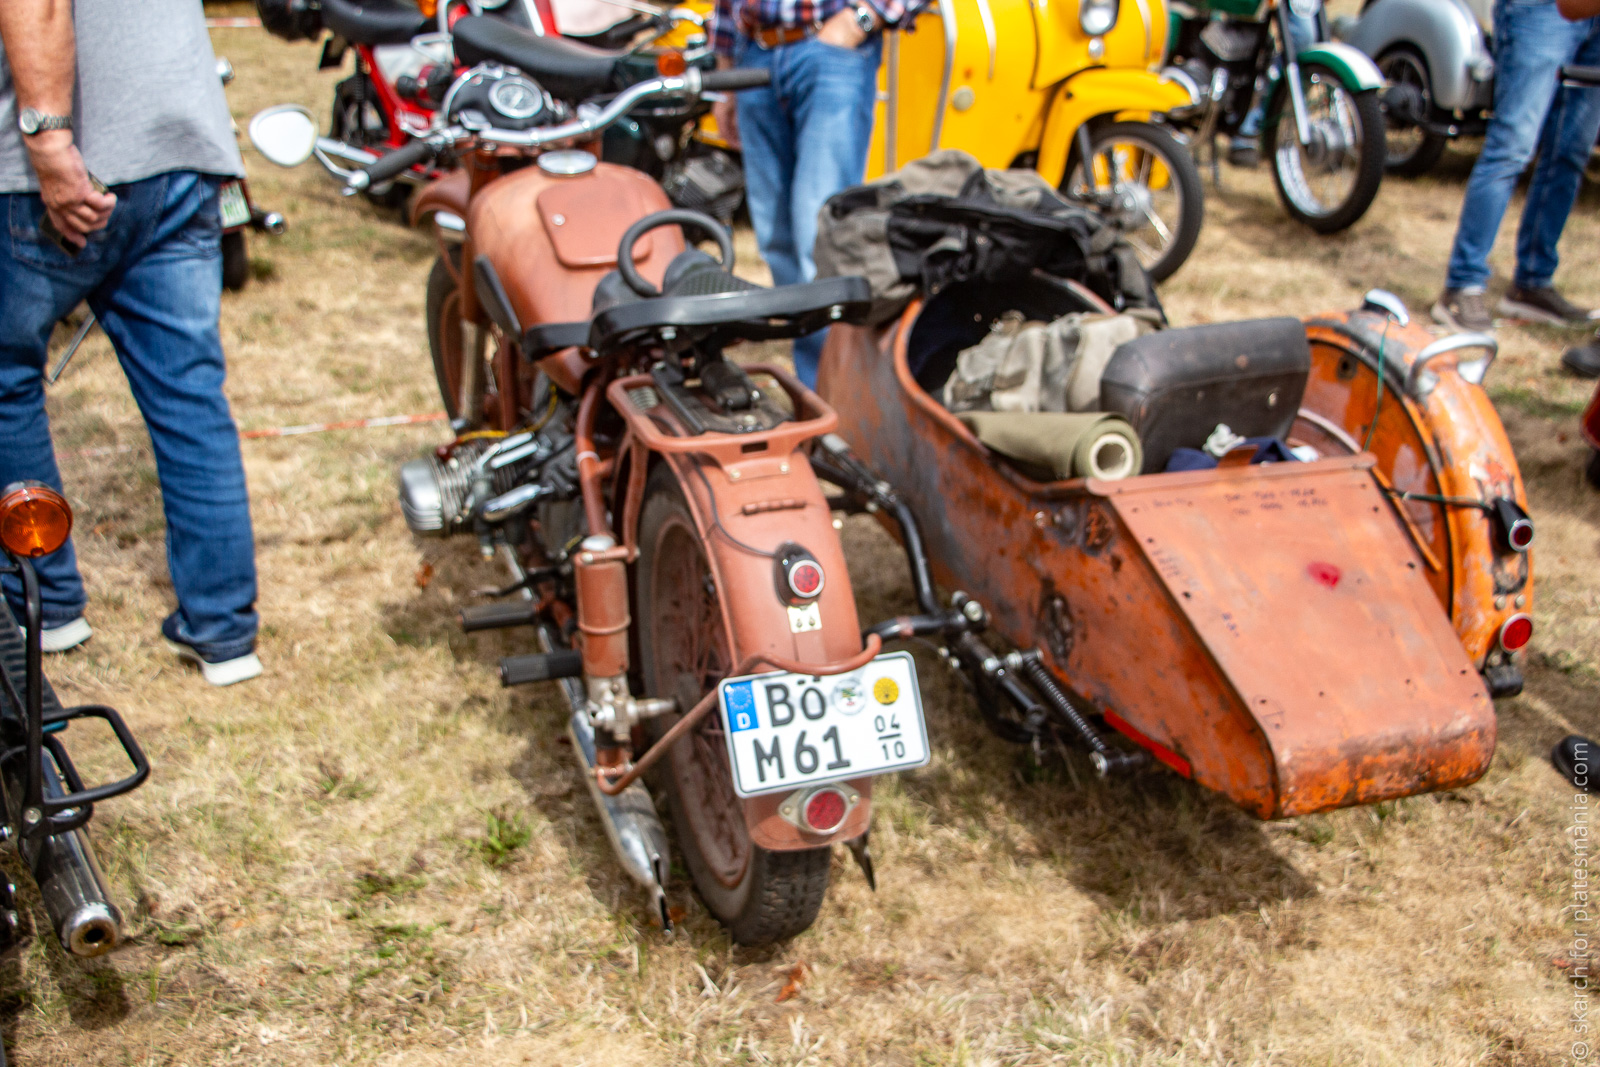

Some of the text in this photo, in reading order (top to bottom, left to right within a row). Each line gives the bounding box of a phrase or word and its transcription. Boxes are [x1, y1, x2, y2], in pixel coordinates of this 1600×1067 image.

[765, 678, 827, 727] BÖ
[737, 713, 751, 729] D
[875, 713, 900, 732] 04
[881, 740, 906, 760] 10
